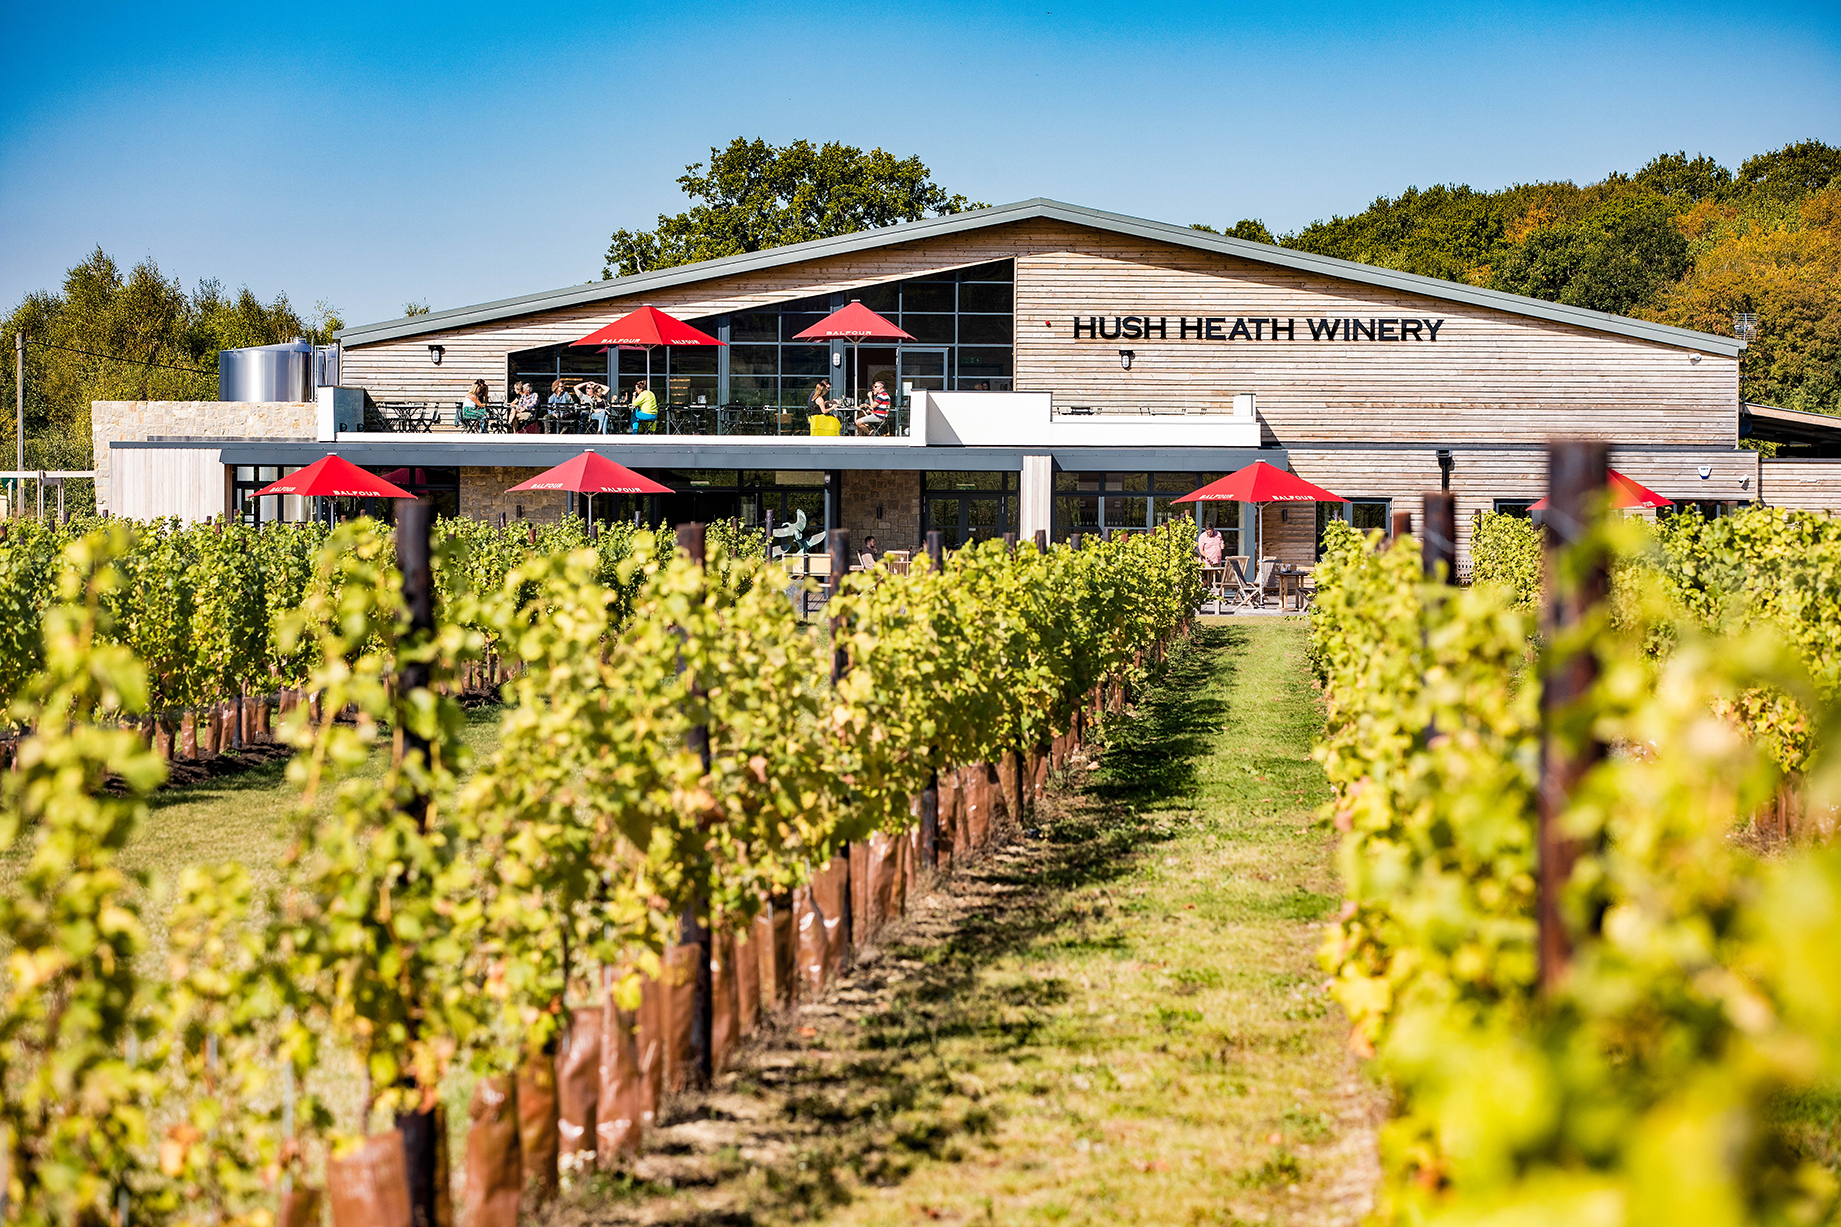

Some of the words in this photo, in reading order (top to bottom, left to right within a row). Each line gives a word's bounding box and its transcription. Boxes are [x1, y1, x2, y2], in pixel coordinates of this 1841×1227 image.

[1073, 316, 1166, 340] HUSH
[1180, 317, 1295, 341] HEATH
[1306, 318, 1445, 342] WINERY
[333, 489, 381, 497] BALFOUR
